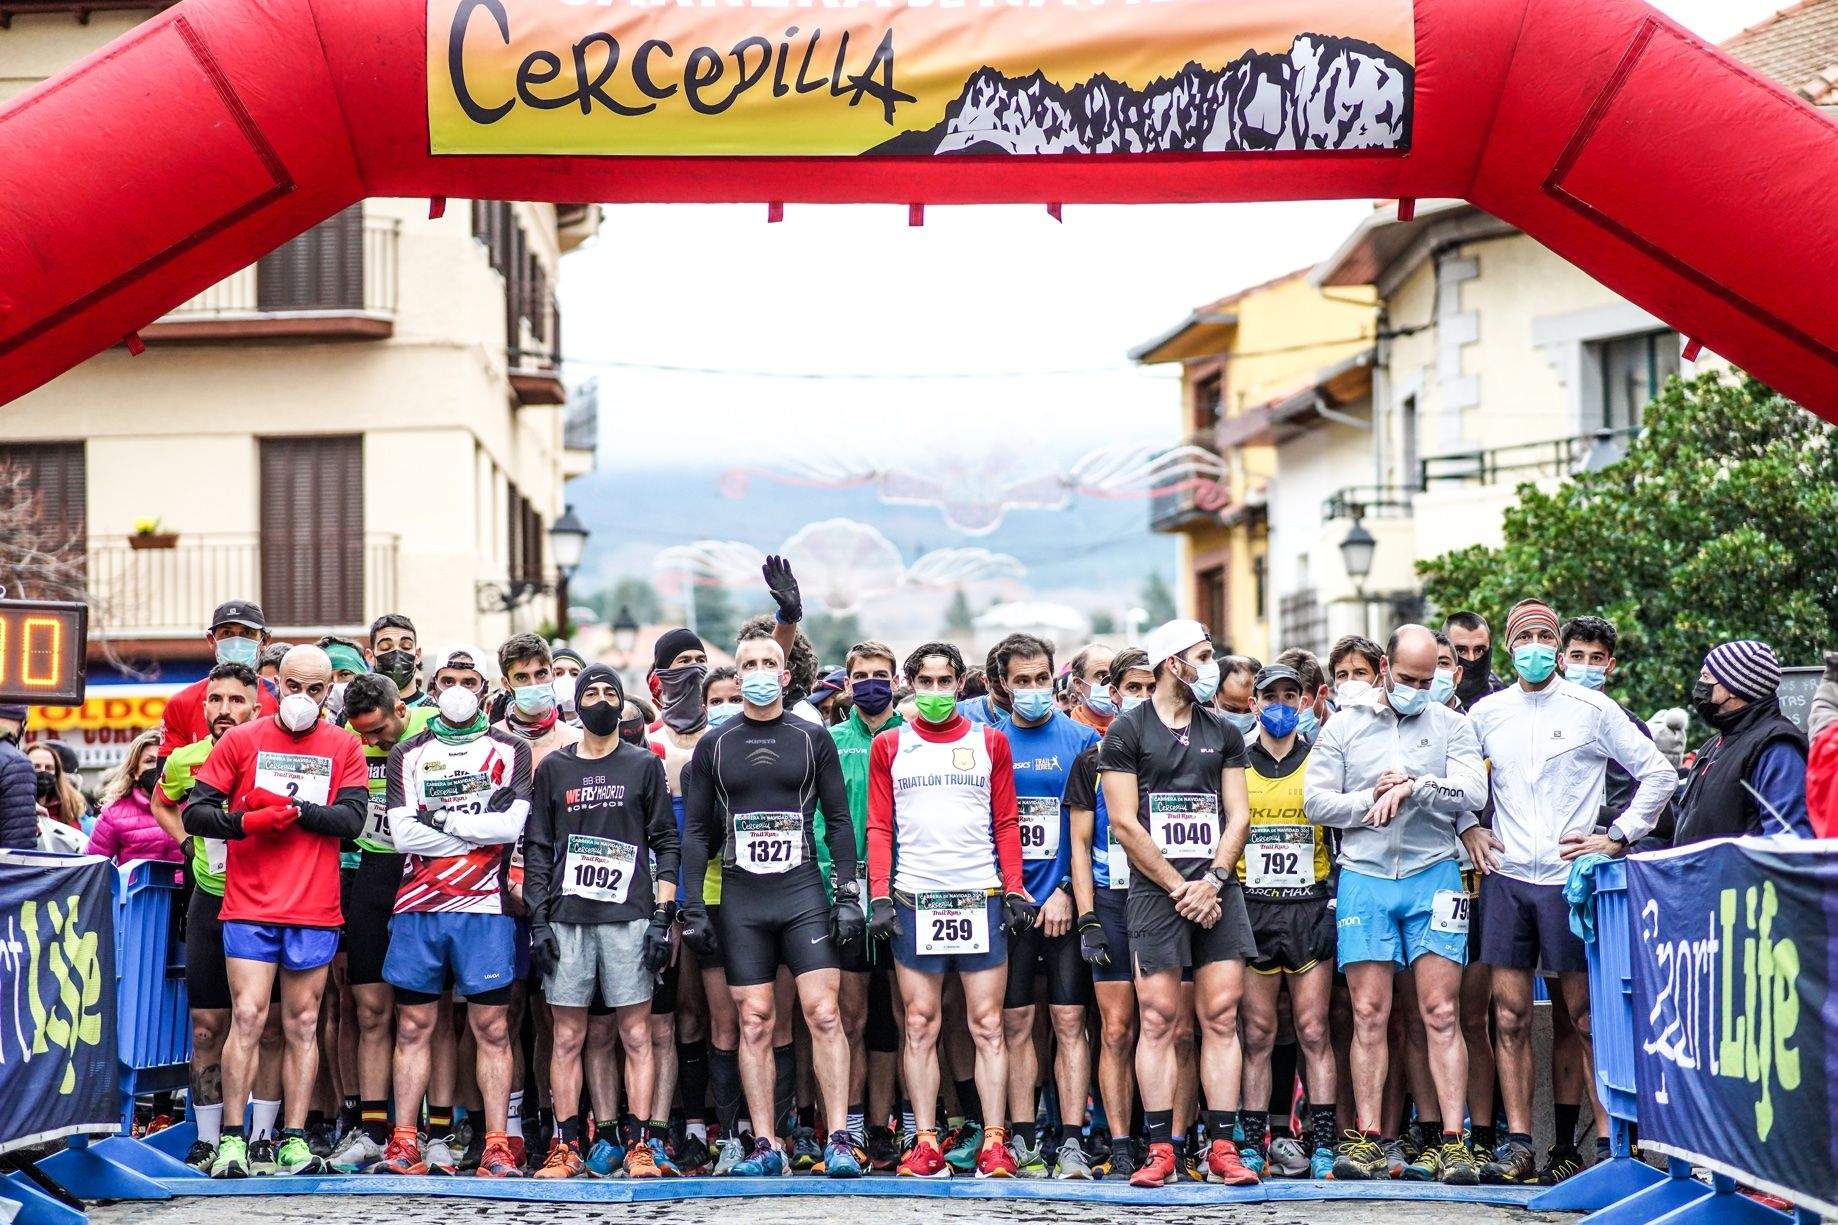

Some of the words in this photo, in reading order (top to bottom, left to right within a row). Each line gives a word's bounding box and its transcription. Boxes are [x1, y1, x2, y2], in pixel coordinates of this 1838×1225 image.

[0, 615, 61, 686] 0
[39, 699, 165, 720] OLDO
[369, 763, 387, 779] iat
[944, 774, 986, 787] TRUJILLO
[286, 782, 299, 798] 2
[566, 788, 581, 805] WE
[581, 786, 598, 802] FLY
[597, 785, 625, 800] MADRID
[1422, 780, 1464, 797] samon
[1161, 822, 1212, 846] 1040
[747, 840, 792, 863] 1327
[1261, 852, 1299, 875] 792
[574, 864, 623, 891] 1092
[1282, 886, 1312, 898] MAX
[1451, 897, 1469, 920] 79
[932, 918, 973, 941] 259
[1719, 880, 1802, 1143] Life
